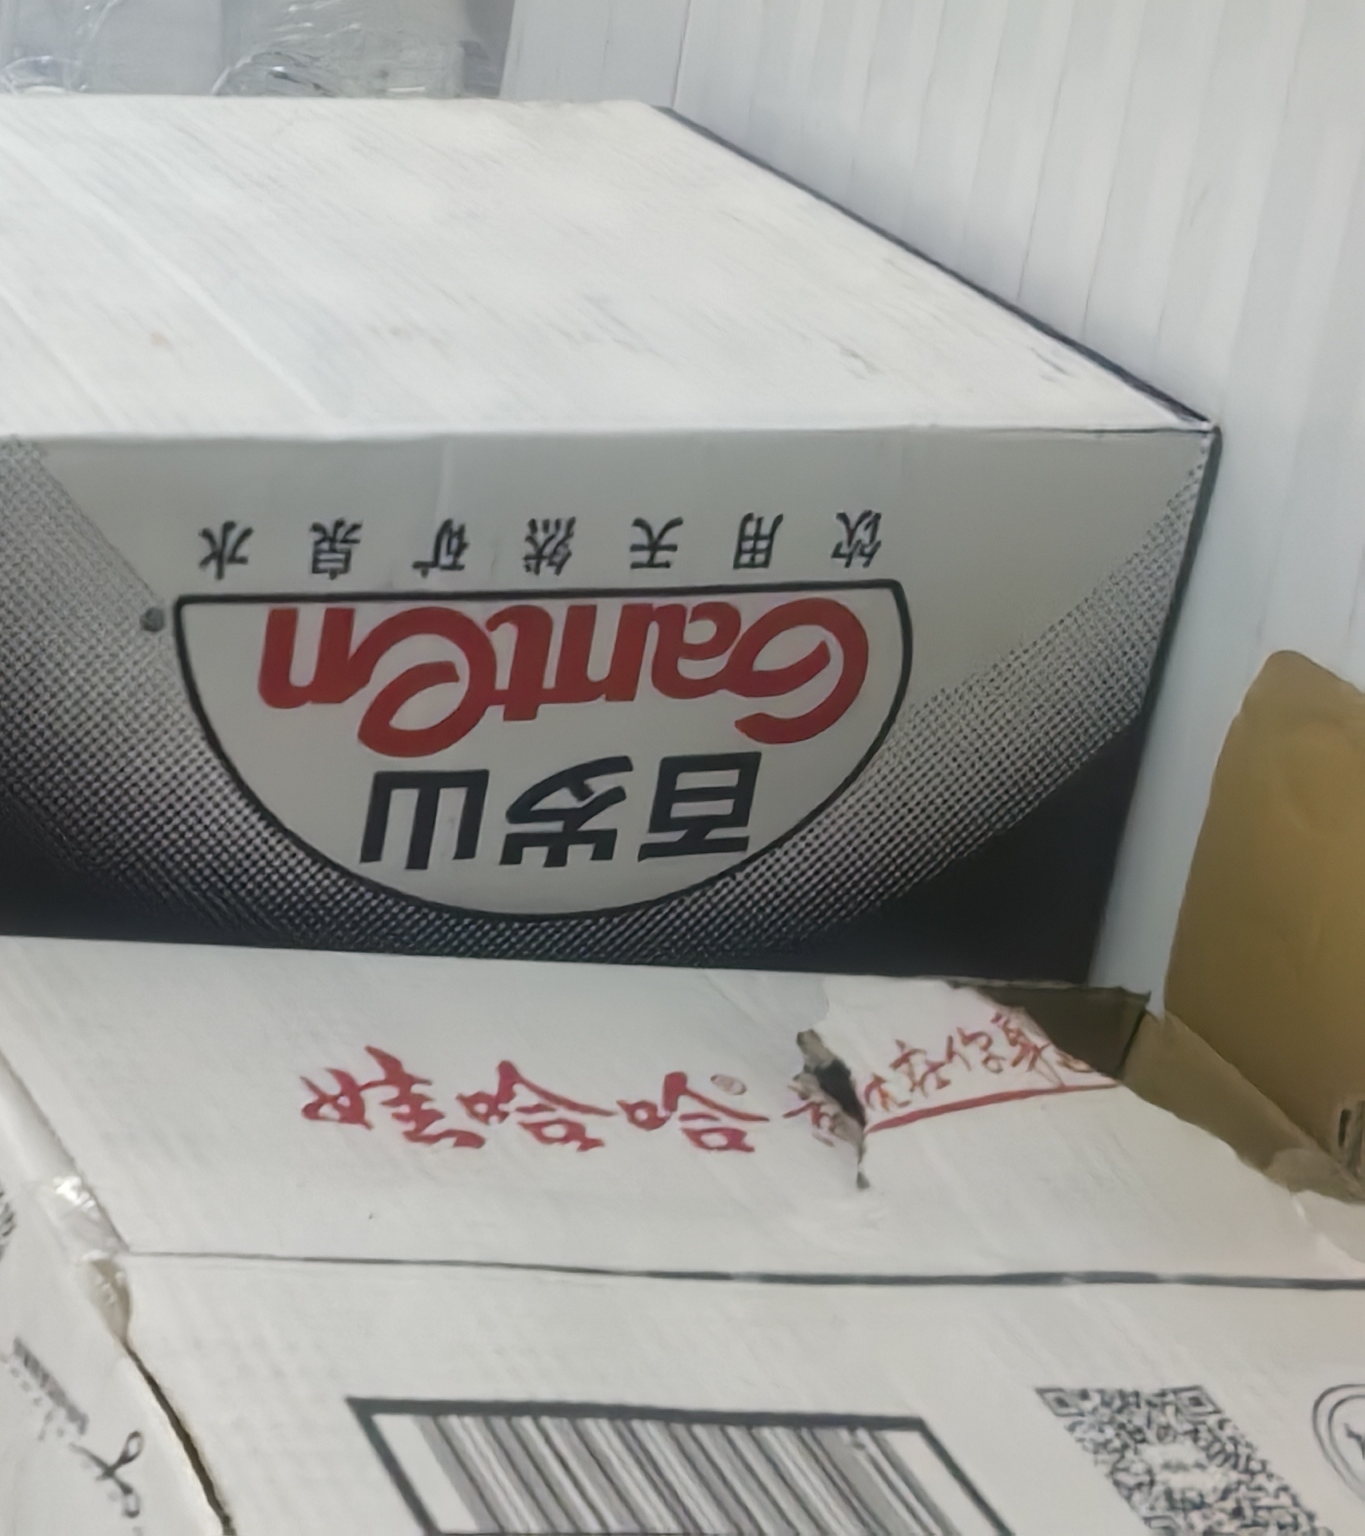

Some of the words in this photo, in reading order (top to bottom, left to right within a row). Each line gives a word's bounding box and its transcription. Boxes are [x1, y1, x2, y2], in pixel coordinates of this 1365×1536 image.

[197, 508, 883, 581] 饮用天然矿泉水
[257, 596, 870, 758] Ganten
[359, 750, 763, 871] 百岁山
[300, 1045, 768, 1155] 娃哈哈
